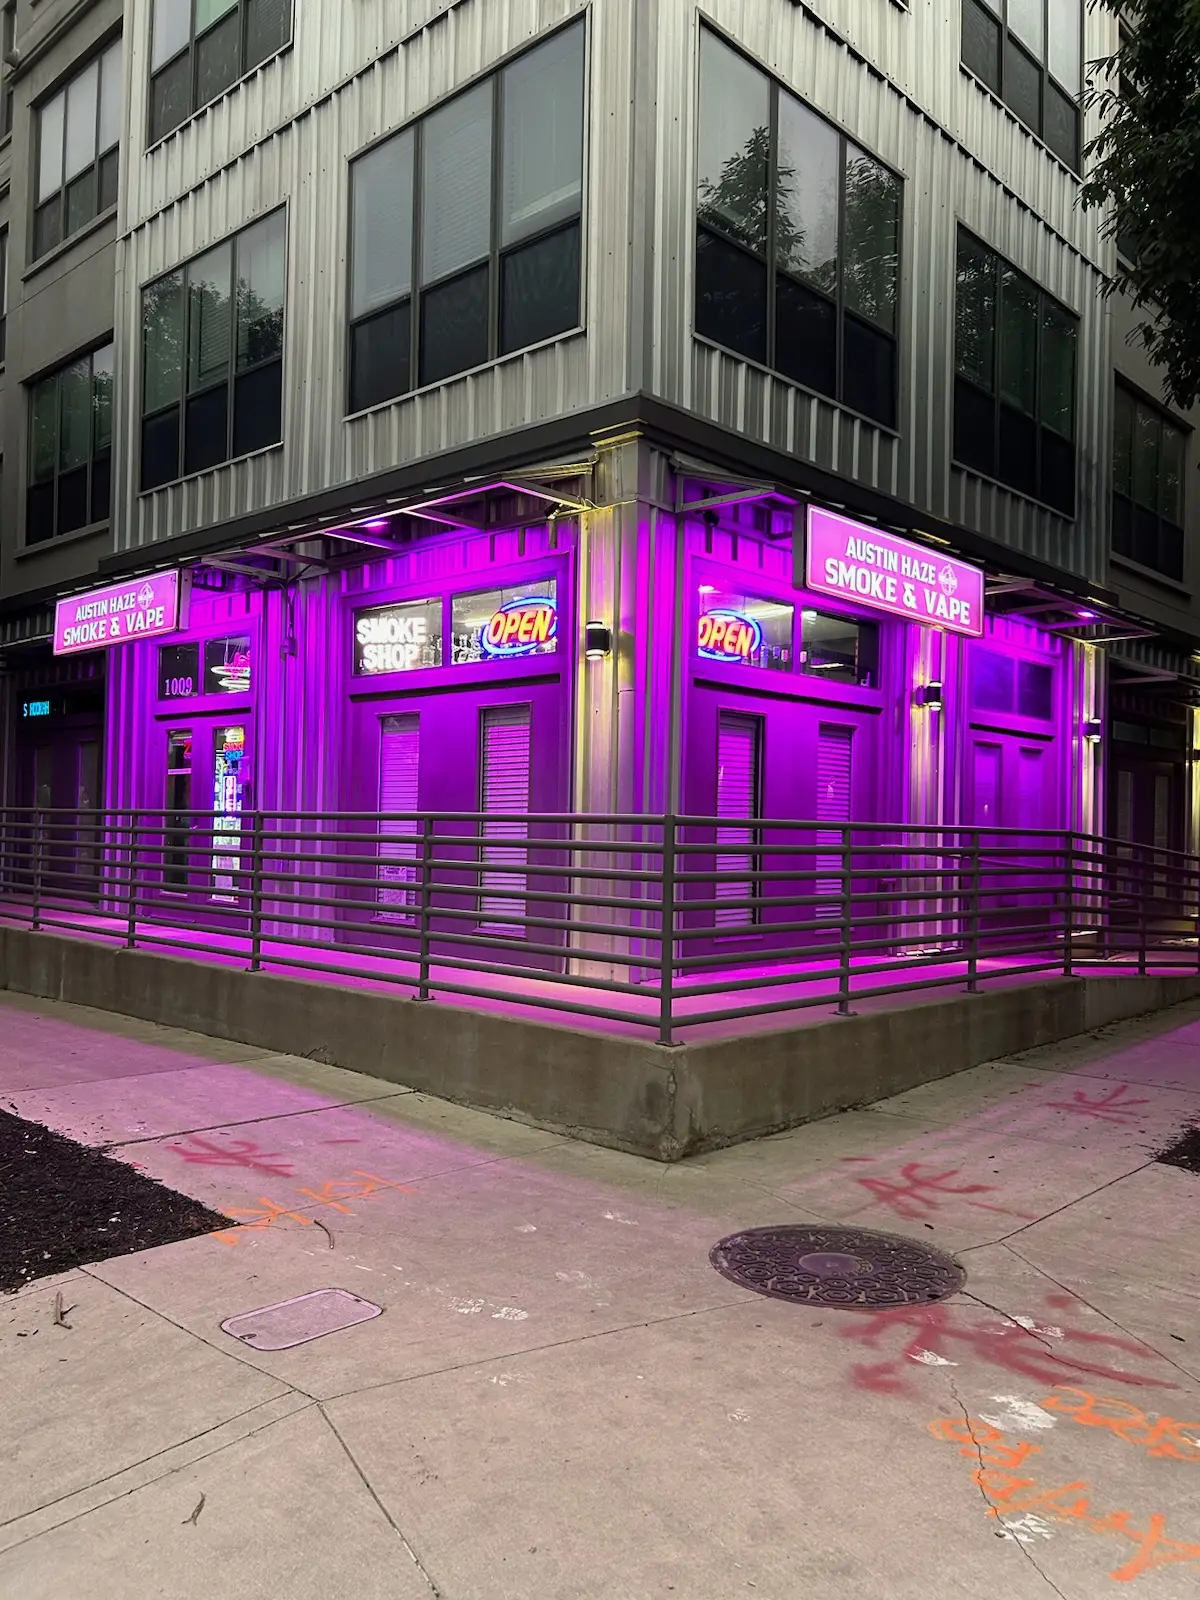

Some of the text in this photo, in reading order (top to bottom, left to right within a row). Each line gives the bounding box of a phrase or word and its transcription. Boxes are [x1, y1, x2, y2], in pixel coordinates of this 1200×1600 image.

[845, 536, 937, 586] AUSTIN HAZE
[824, 557, 971, 625] SMOKE & VAPE
[75, 596, 136, 623] AUSTIN HAZE
[488, 607, 553, 645] OPEN
[63, 606, 165, 647] SMOKE & VAPE
[356, 617, 427, 645] SMOKE
[698, 616, 752, 656] OPEN
[362, 643, 420, 670] SHOP
[164, 676, 193, 697] 1009
[225, 750, 244, 761] SHOP
